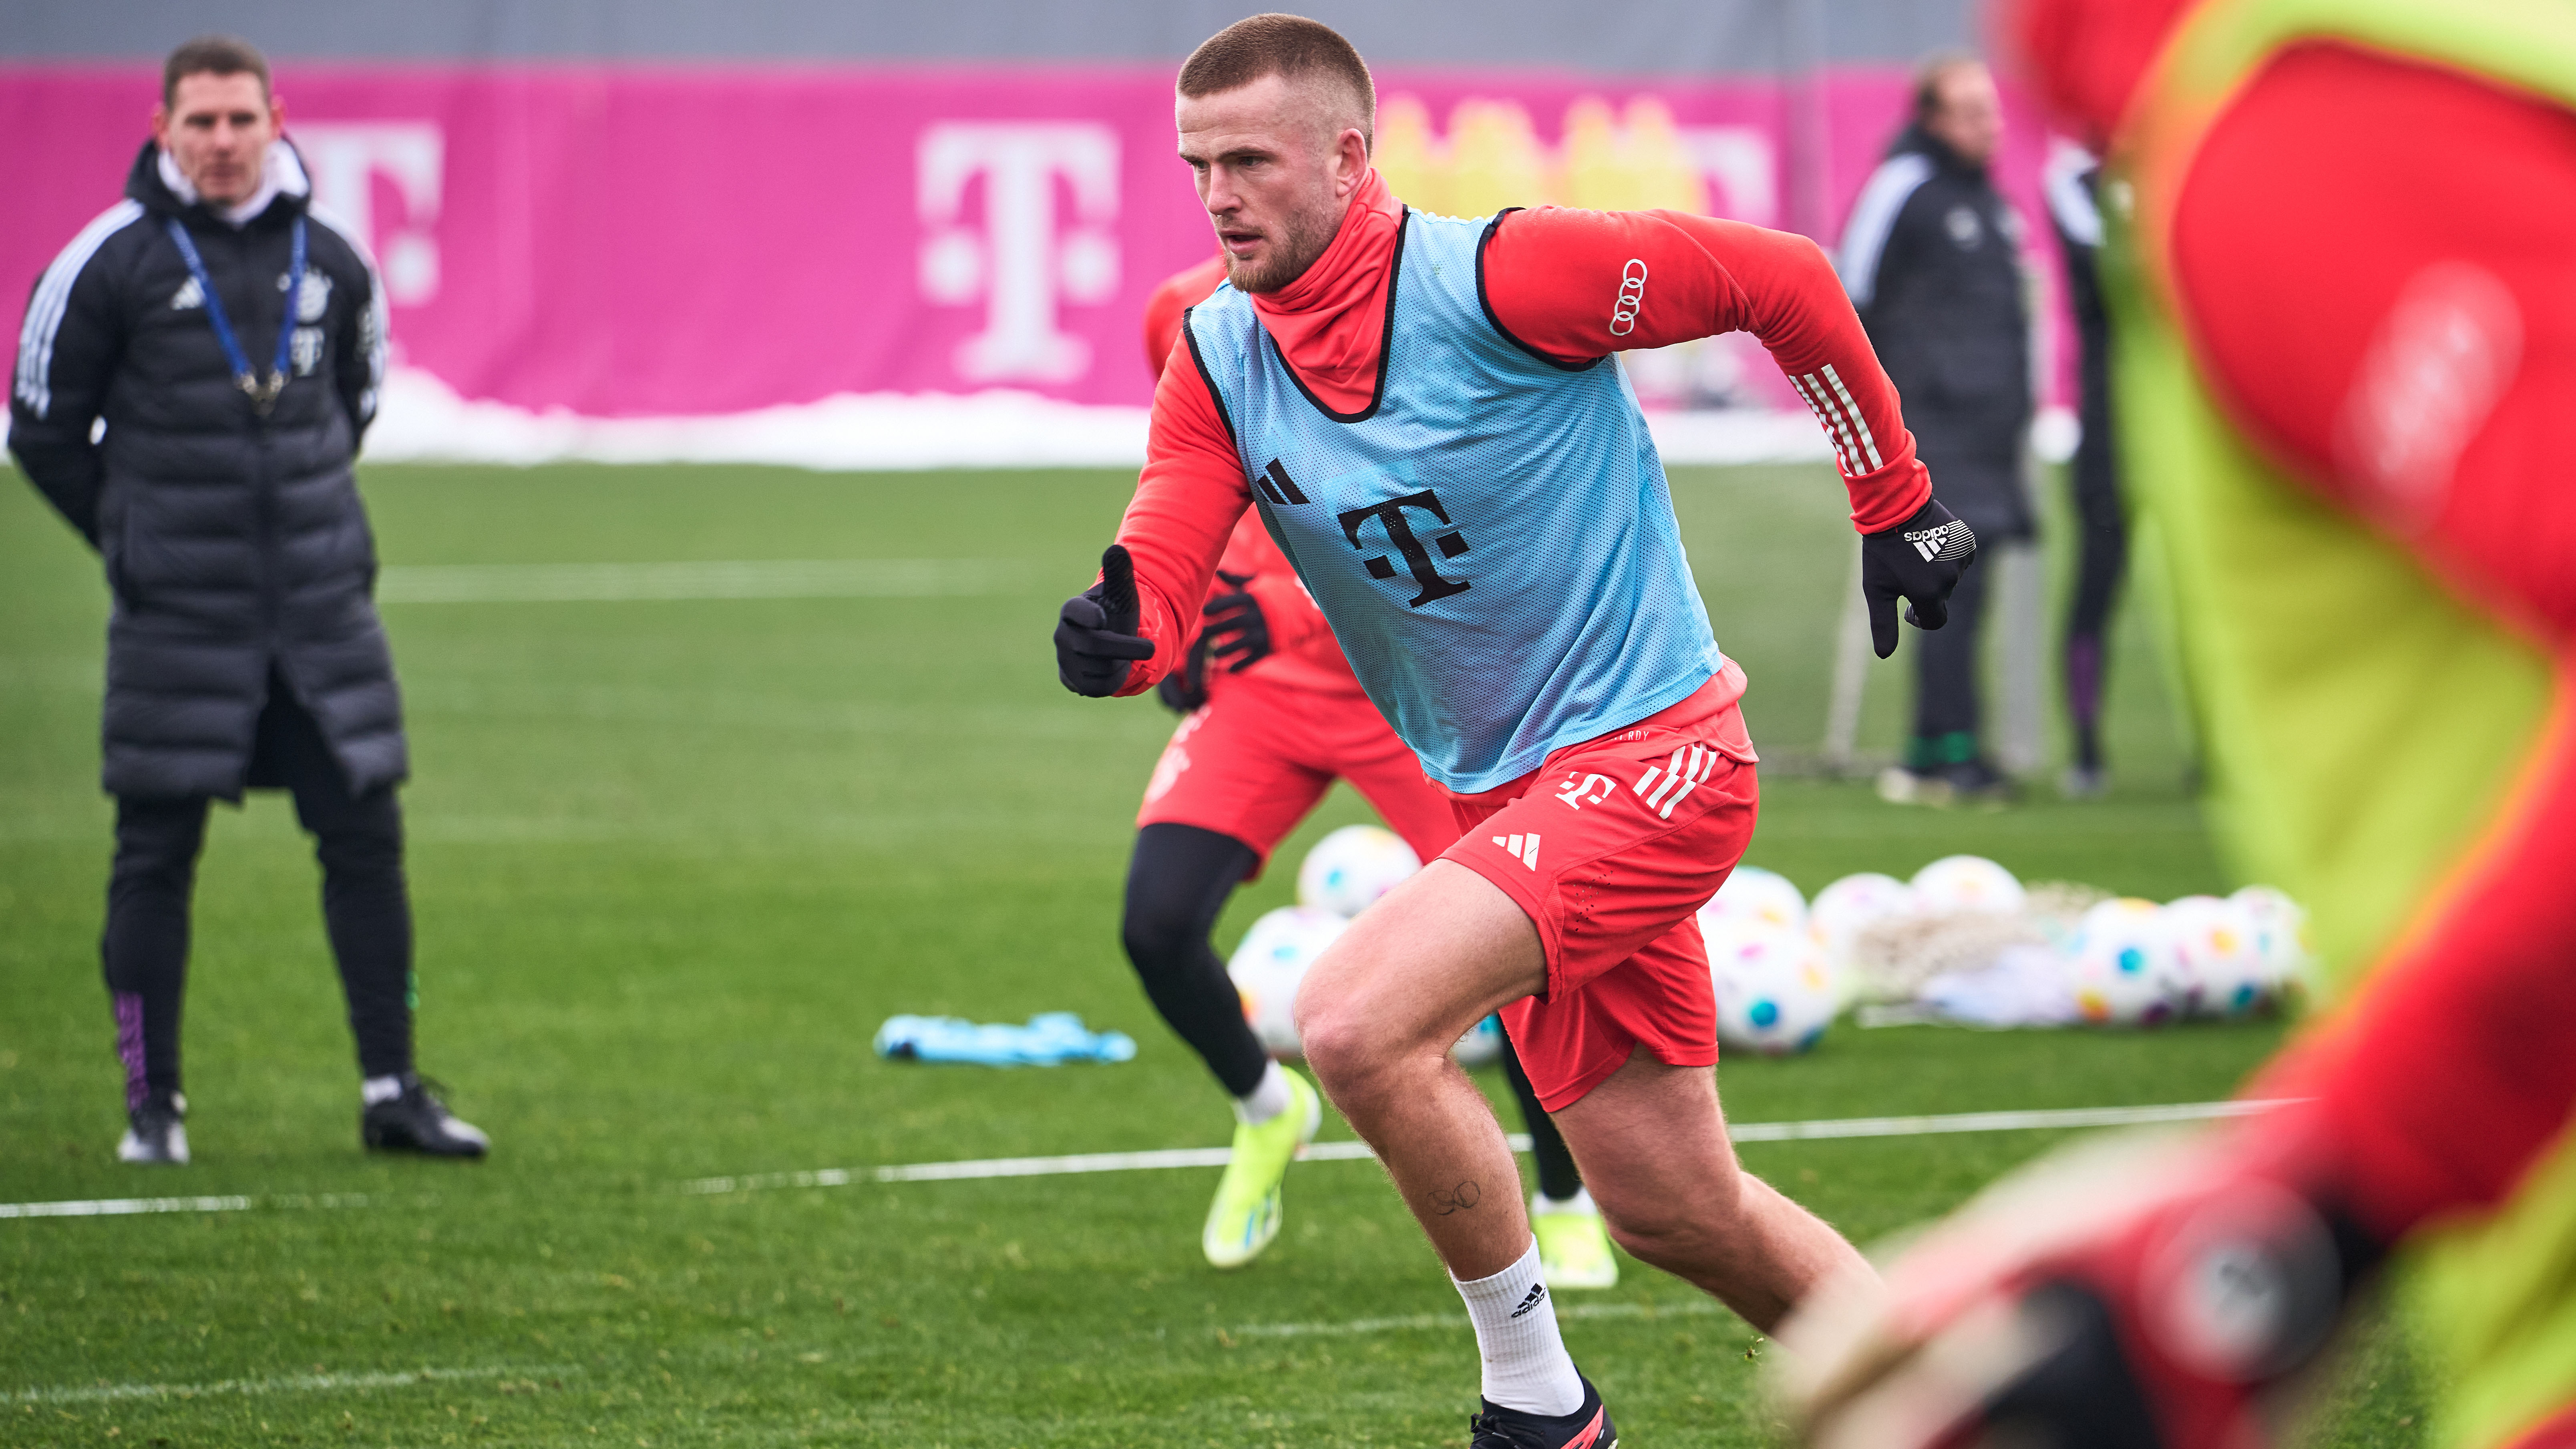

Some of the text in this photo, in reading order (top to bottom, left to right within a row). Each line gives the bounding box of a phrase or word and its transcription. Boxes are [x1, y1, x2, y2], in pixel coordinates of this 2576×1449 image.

[917, 121, 1120, 383] T
[1336, 488, 1472, 608] T
[1904, 525, 1949, 542] adidas
[1554, 771, 1617, 810] T
[1511, 1288, 1546, 1318] adida
